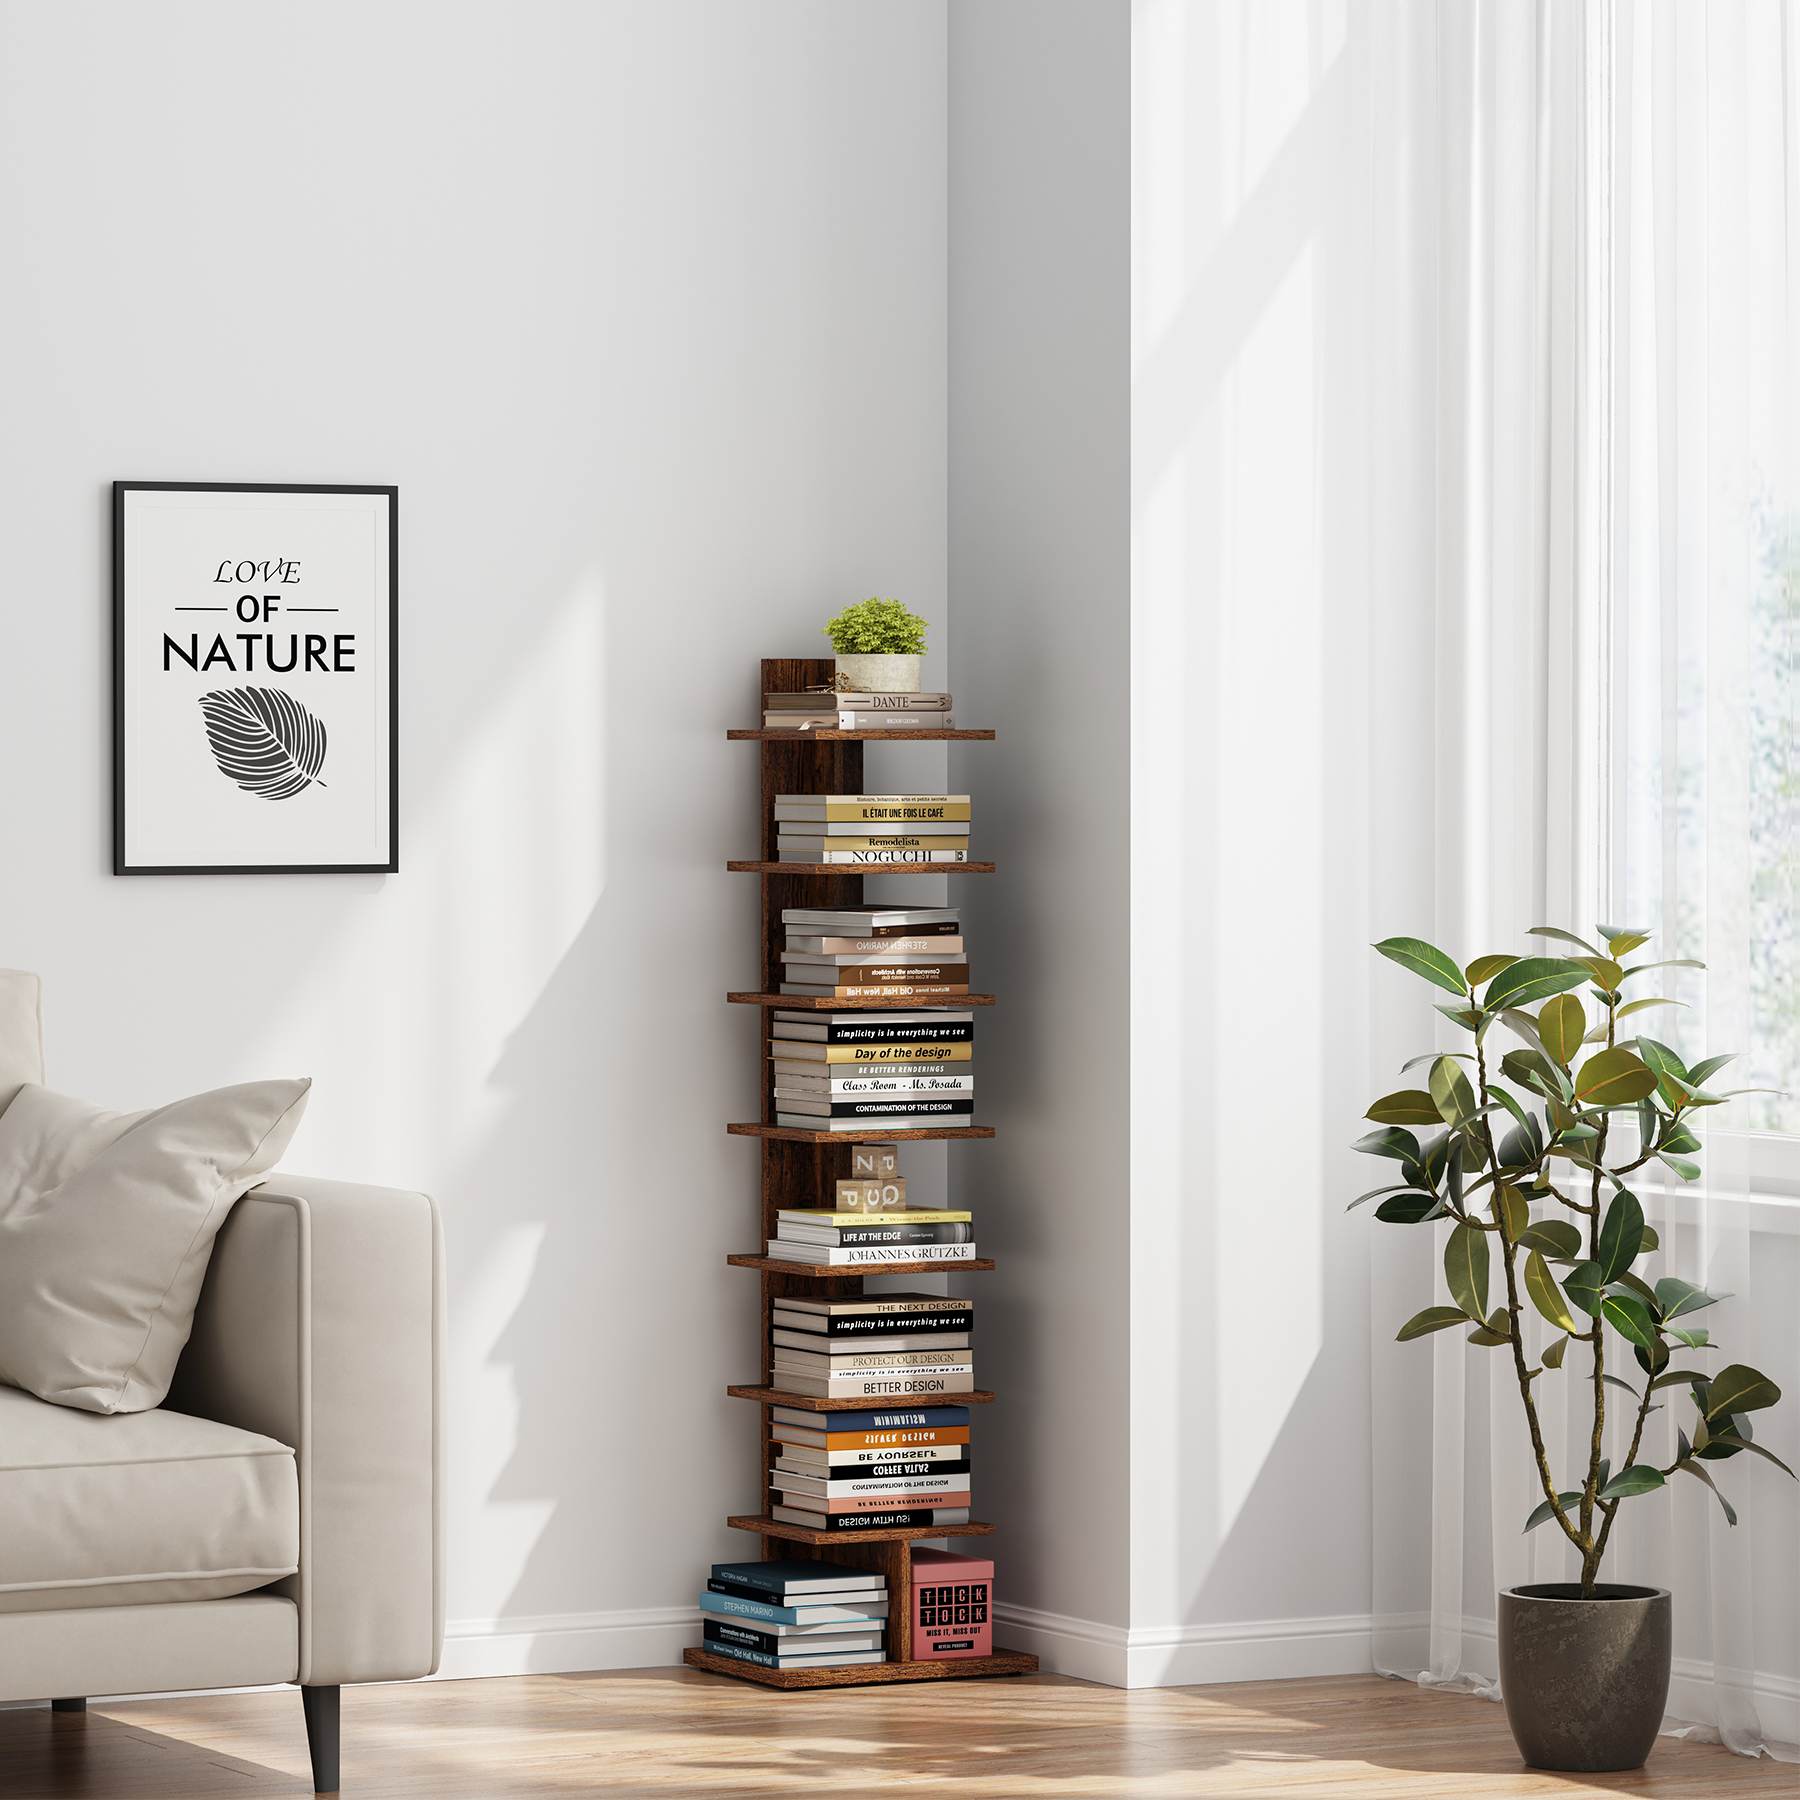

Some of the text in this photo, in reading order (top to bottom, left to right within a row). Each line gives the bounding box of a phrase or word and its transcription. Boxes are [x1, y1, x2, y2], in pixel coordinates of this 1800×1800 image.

[213, 558, 301, 584] LOVE
[236, 594, 281, 623] OF
[163, 632, 356, 672] NATURE
[873, 696, 909, 708] DANTE
[862, 807, 944, 818] IL ÉTAIT UNE FOIS LE CAFÉ
[869, 838, 920, 846] Remodelista
[852, 850, 932, 862] NOGUCHI
[837, 1030, 875, 1039] simplicity
[897, 1029, 937, 1038] everything
[855, 1047, 951, 1060] Day of the design
[842, 1080, 867, 1090] Class
[870, 1080, 896, 1090] Room
[908, 1079, 926, 1089] Ms.
[928, 1079, 962, 1089] Posada
[856, 1104, 906, 1112] CONTAMINATION
[882, 1156, 894, 1170] P
[842, 1190, 858, 1206] P
[882, 1185, 899, 1206] Q
[843, 1233, 857, 1242] LIFE
[858, 1233, 868, 1241] AT
[868, 1232, 881, 1241] THE
[883, 1232, 901, 1240] EDGE
[847, 1246, 968, 1262] JOHANNES GRÜTZKE
[837, 1321, 875, 1330] simplicity
[897, 1318, 937, 1328] everything
[853, 1354, 955, 1366] PROTECT OUR DESIGN
[864, 1380, 944, 1394] BETTER DESIGN
[925, 1588, 982, 1604] TICK
[723, 1601, 773, 1617] STEPHEN MARINO
[925, 1608, 982, 1623] TOCK
[753, 1653, 762, 1662] New
[764, 1656, 772, 1665] Hall
